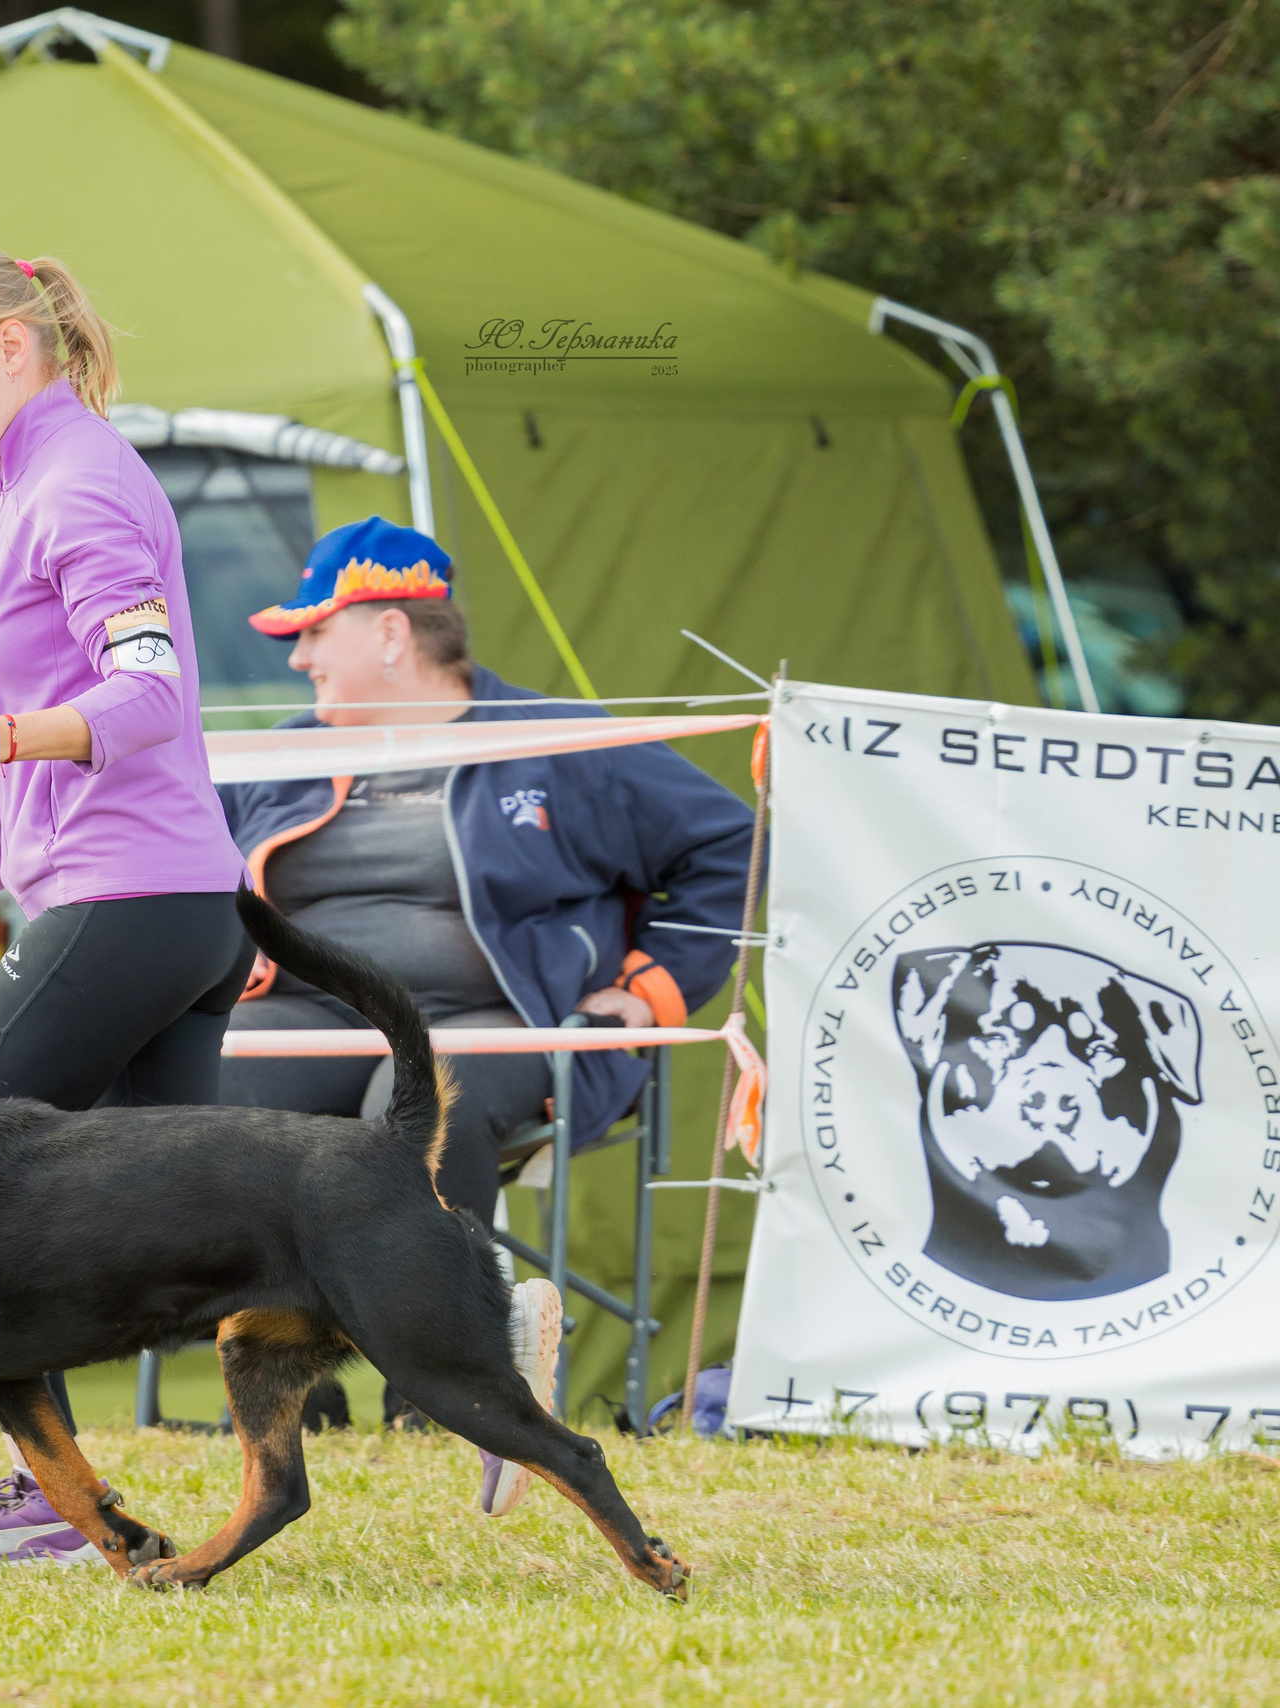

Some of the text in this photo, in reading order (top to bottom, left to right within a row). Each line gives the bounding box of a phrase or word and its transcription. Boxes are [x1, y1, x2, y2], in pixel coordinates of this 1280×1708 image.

[135, 637, 166, 664] 58
[940, 728, 1280, 790] SERDTSA
[1071, 879, 1216, 987] TAVRIDY
[813, 871, 1023, 1174] IZ SERDTSA TAVRIDY
[1249, 1186, 1276, 1223] IZ
[851, 1221, 1230, 1350] IZ SERDTSA TAVRIDY
